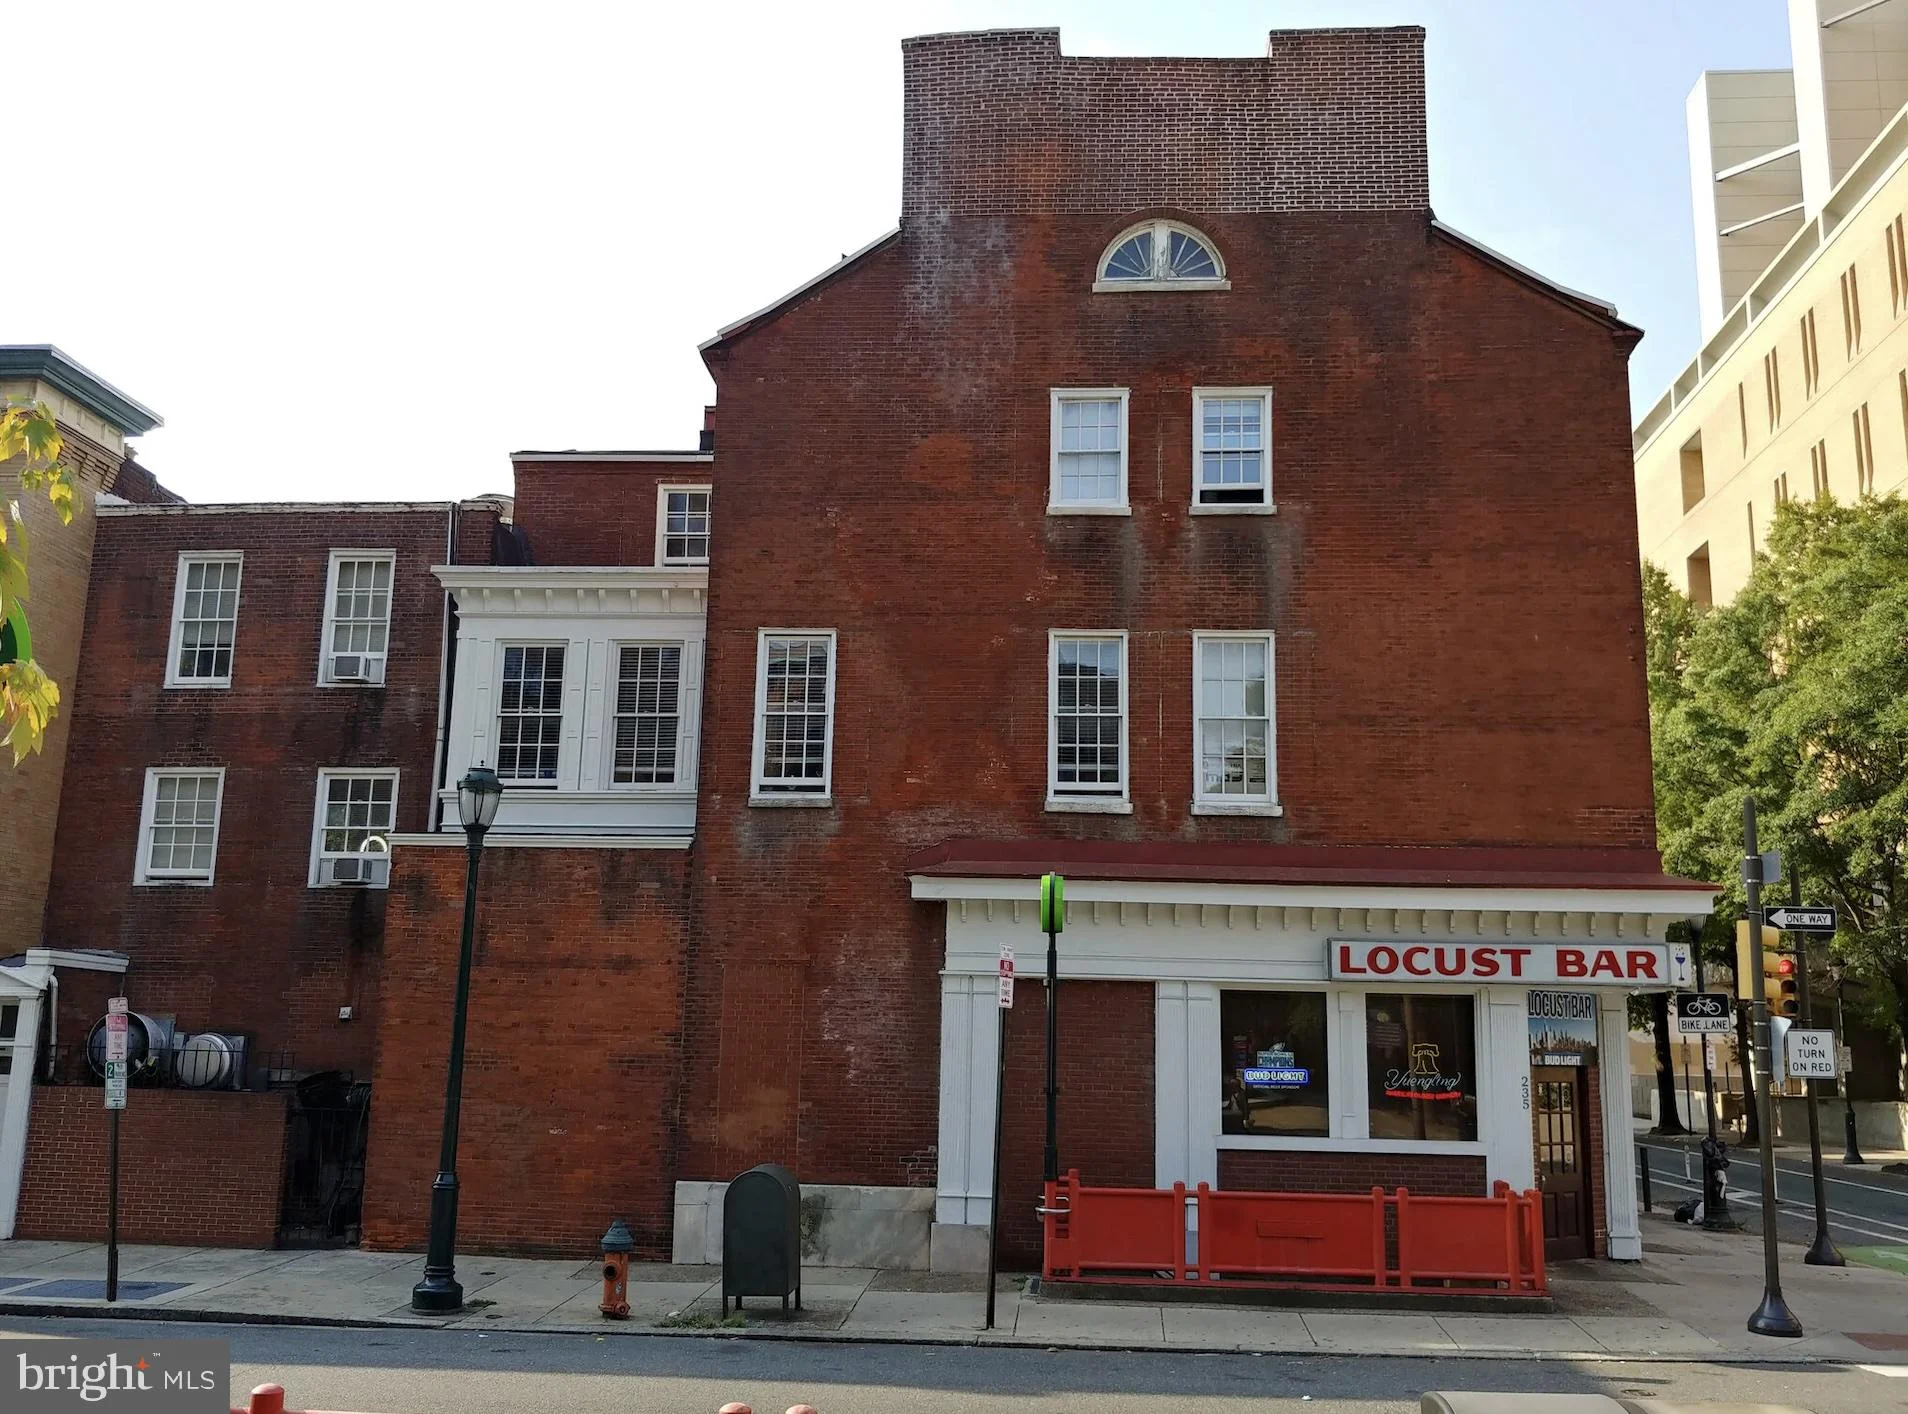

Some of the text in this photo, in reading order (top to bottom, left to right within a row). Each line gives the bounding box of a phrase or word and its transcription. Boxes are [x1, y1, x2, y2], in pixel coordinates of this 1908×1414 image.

[1786, 914, 1829, 924] ONE WAY
[1339, 945, 1660, 979] LOCUST BAR
[1527, 991, 1593, 1019] LOCUST BAR
[1681, 1020, 1729, 1030] BIKE LANE
[1802, 1036, 1819, 1046] NO
[1798, 1049, 1826, 1059] TURN
[1544, 1055, 1561, 1065] BUD
[1561, 1056, 1581, 1066] LIGHT
[108, 1064, 113, 1077] 2
[1792, 1062, 1832, 1073] ON RED
[1247, 1070, 1305, 1081] BUD LIGHT
[1384, 1068, 1462, 1091] Yuengling
[1521, 1076, 1530, 1110] 235
